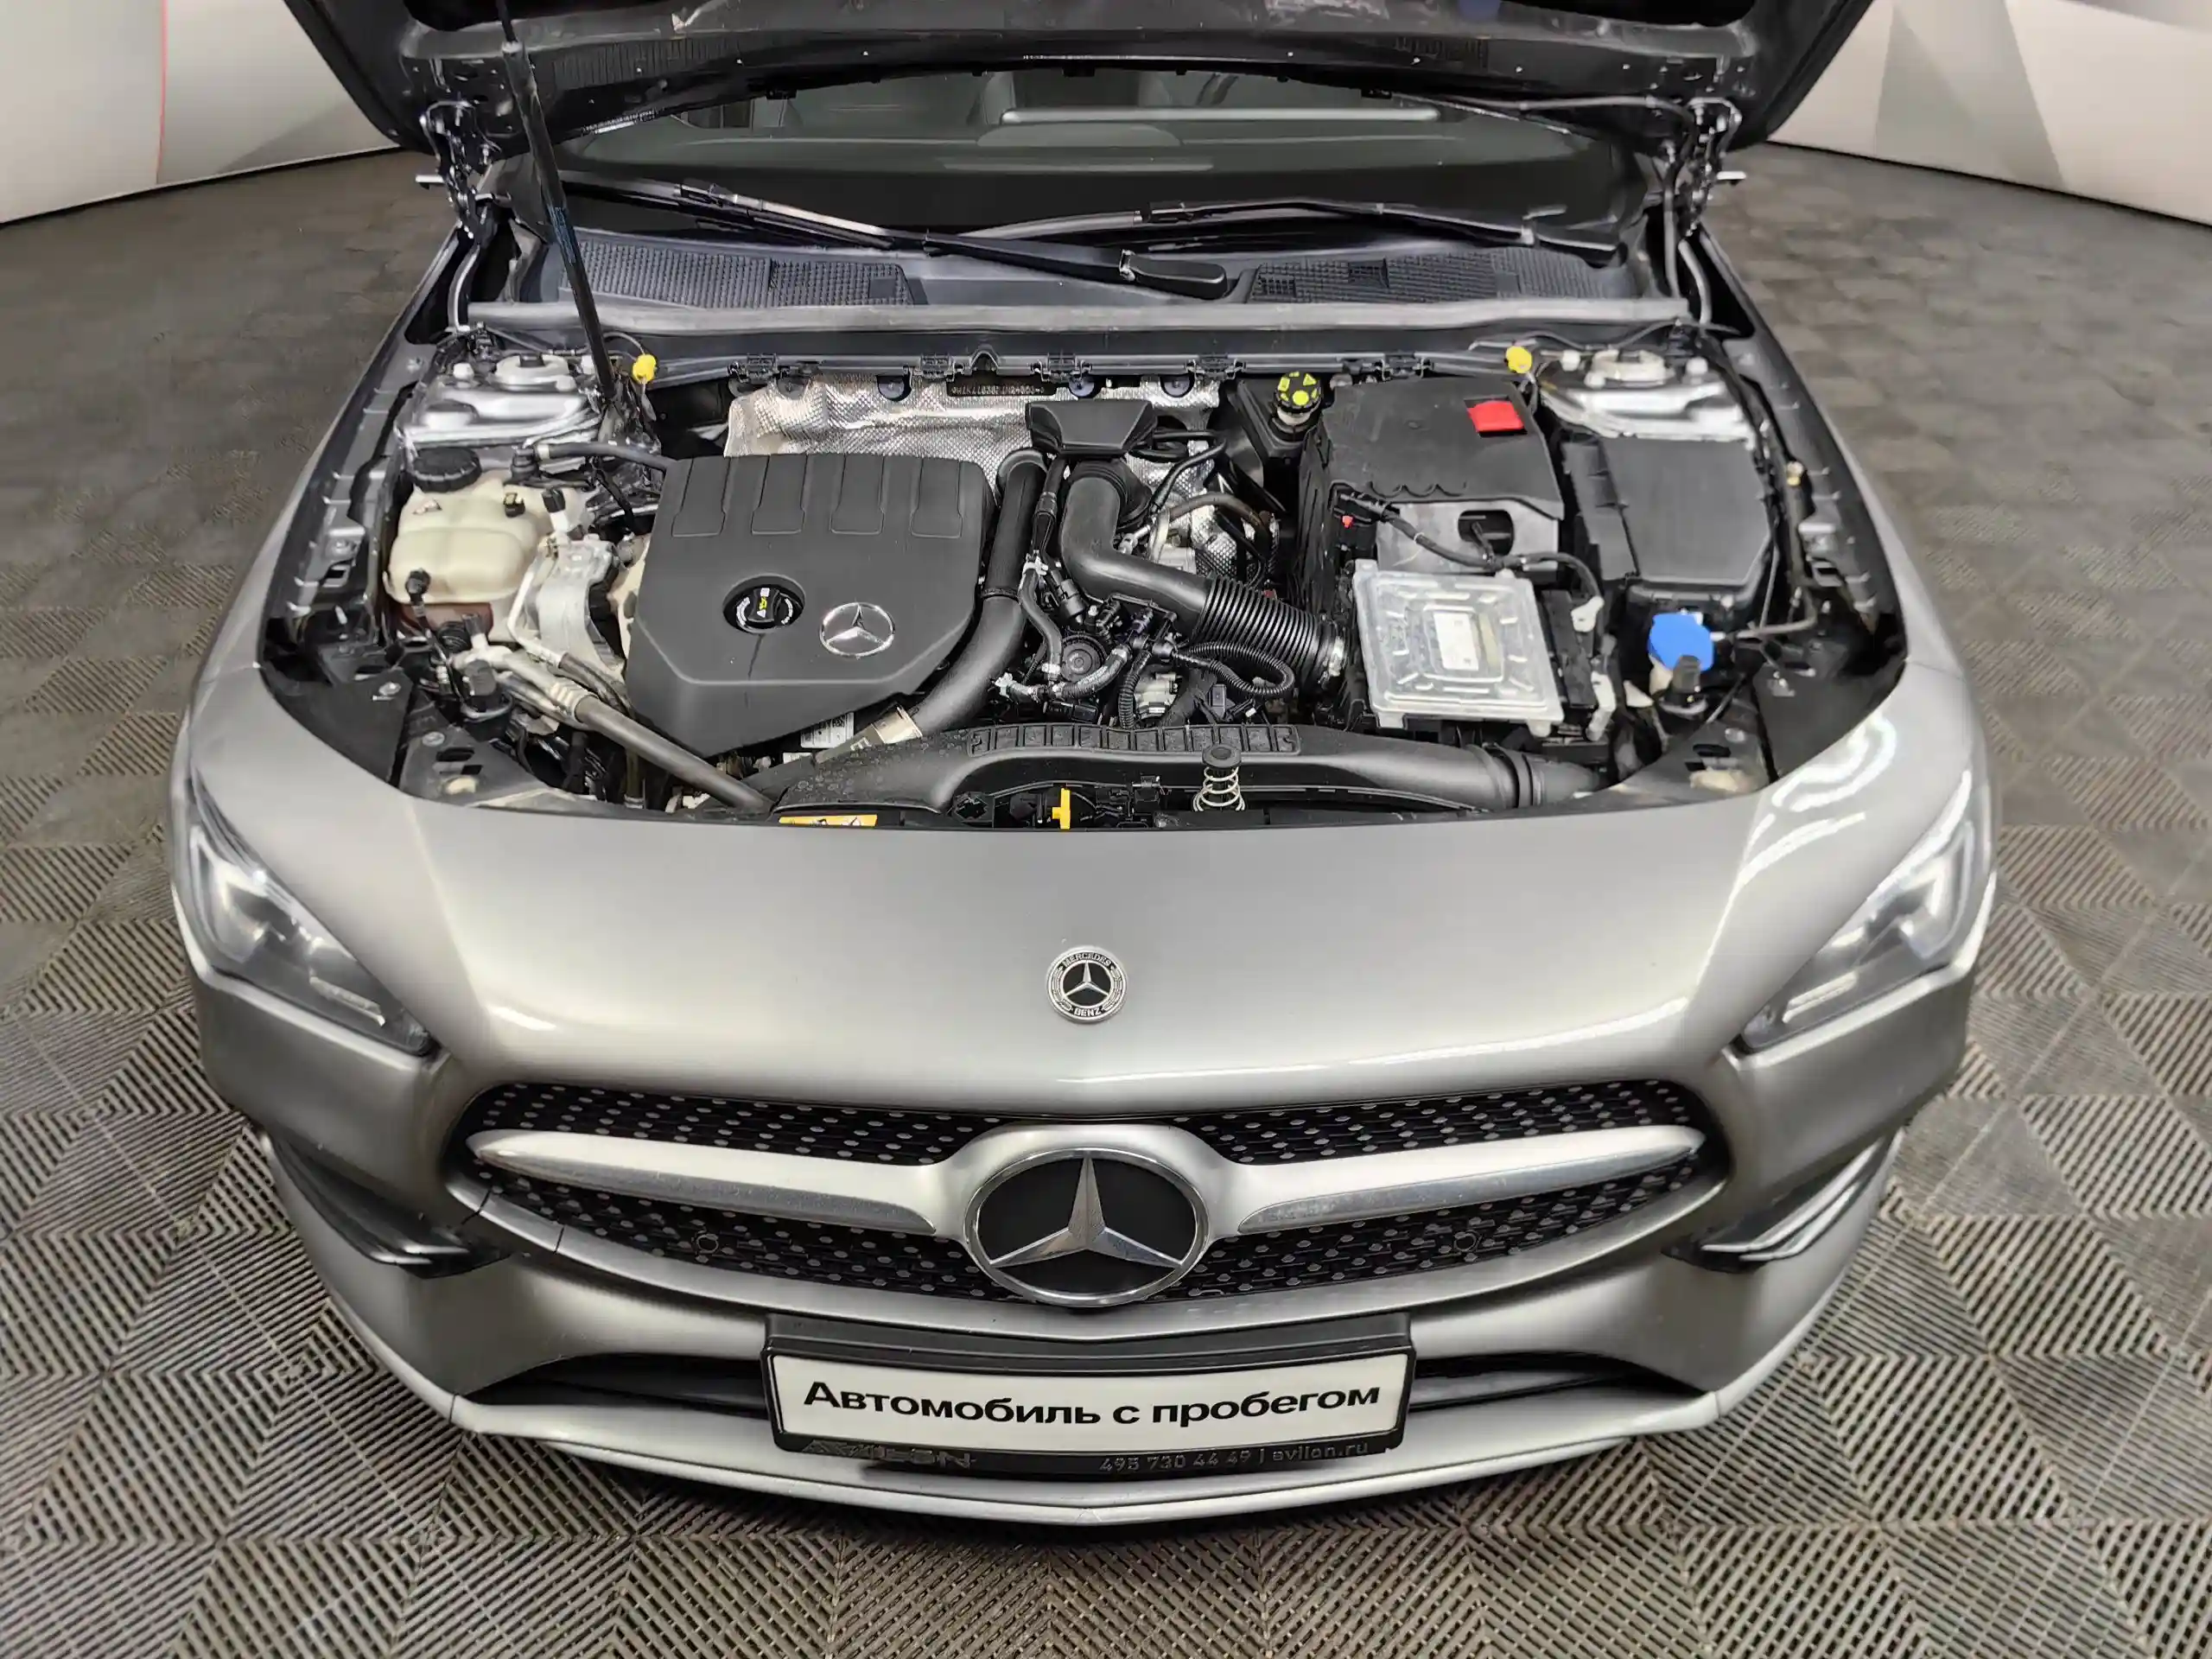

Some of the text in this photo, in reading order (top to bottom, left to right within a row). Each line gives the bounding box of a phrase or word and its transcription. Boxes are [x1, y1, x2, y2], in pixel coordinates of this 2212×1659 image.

[1062, 952, 1112, 967] MERCEDES
[1073, 1007, 1102, 1017] BENZ
[804, 1381, 1381, 1427] Автомобиль с пробегом
[1099, 1457, 1140, 1472] 495
[1147, 1454, 1186, 1470] 730
[1192, 1452, 1220, 1466] 44
[1225, 1449, 1252, 1465] 49
[1272, 1441, 1370, 1462] avilon.ru
